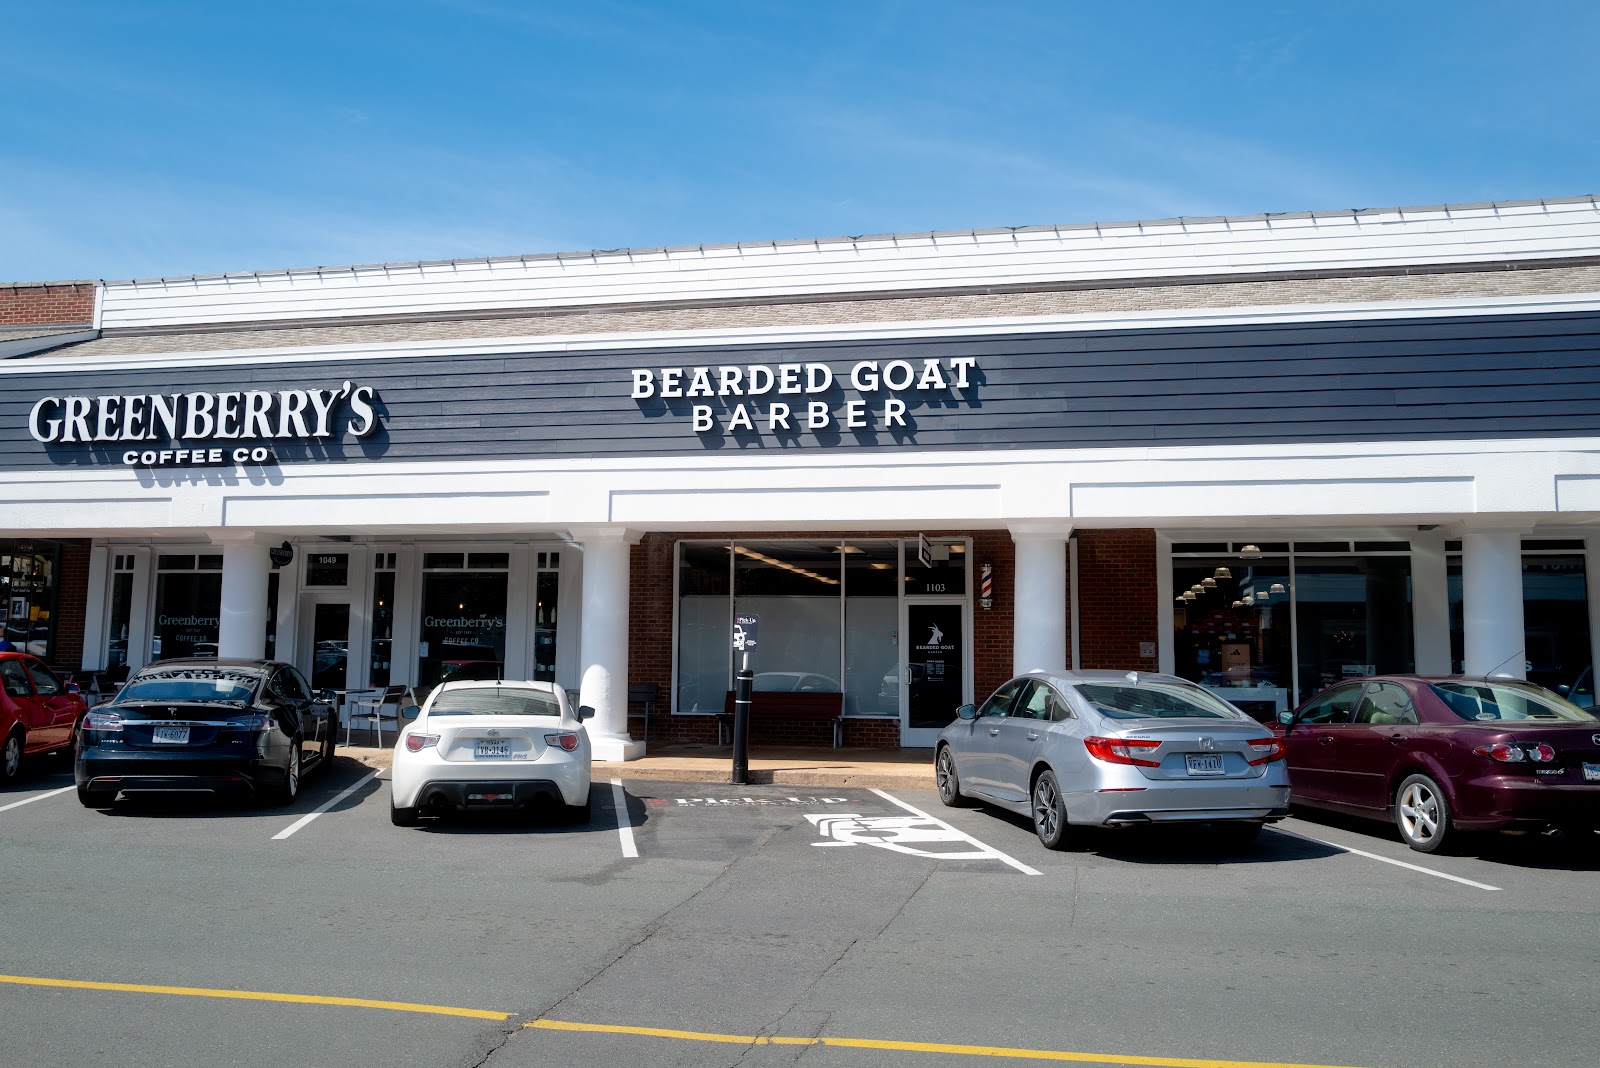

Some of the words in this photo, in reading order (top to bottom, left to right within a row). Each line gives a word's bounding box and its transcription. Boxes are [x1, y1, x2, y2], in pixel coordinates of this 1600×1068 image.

[631, 363, 833, 399] BEARDED
[850, 357, 976, 392] GOAT
[28, 380, 376, 443] GREENBERRY'S
[692, 399, 907, 432] BARBER
[122, 449, 223, 465] COFFEE
[232, 447, 269, 463] CO
[926, 583, 945, 592] 1103
[158, 614, 220, 628] Greenberry
[424, 616, 503, 630] Greenberry's
[175, 634, 197, 642] COFFEE
